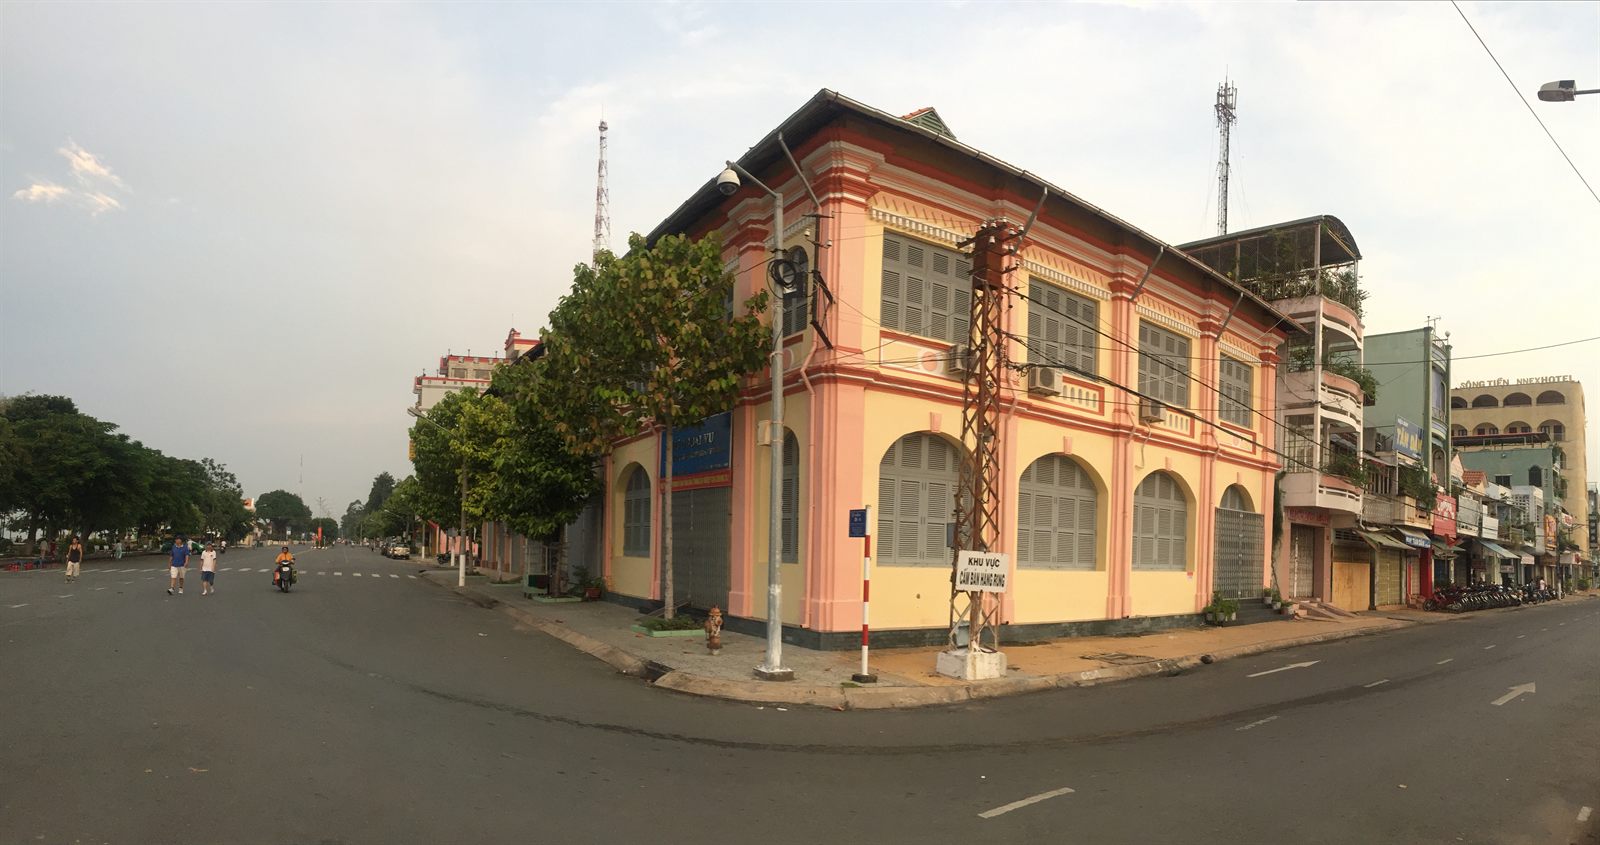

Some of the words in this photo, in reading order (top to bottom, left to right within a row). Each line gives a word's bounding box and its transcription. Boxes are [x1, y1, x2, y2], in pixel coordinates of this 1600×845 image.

[1460, 380, 1485, 388] SÔNG
[968, 557, 984, 566] KHU
[985, 558, 1000, 569] VỰC
